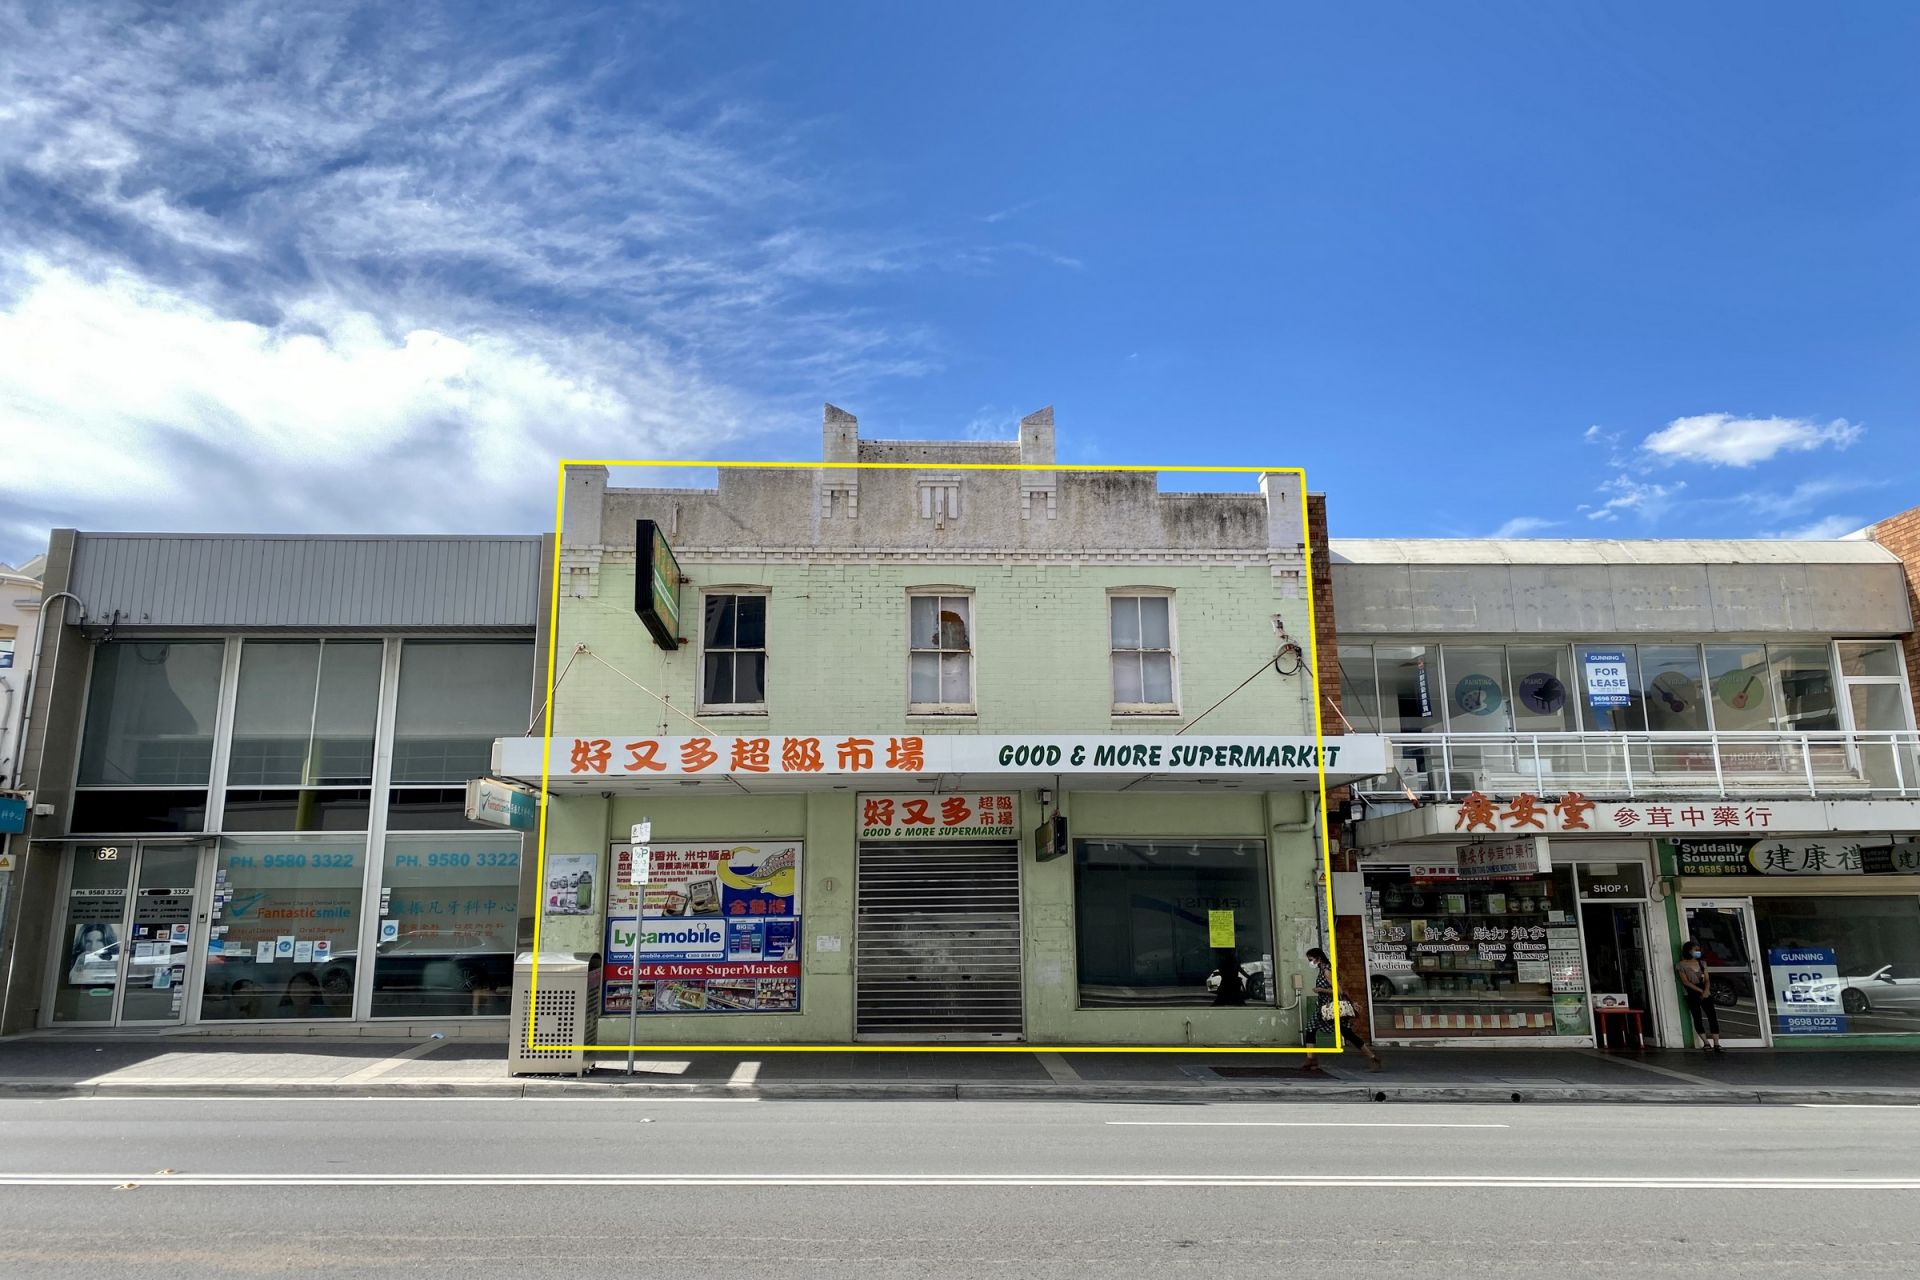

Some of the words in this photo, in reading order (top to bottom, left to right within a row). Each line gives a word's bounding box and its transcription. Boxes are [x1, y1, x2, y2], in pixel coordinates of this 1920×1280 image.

[1595, 668, 1618, 676] FOR
[1590, 679, 1626, 687] LEASE
[570, 737, 925, 773] 好又多超級市場
[998, 744, 1061, 766] GOOD
[1070, 745, 1086, 766] &
[1093, 744, 1162, 767] MORE
[1169, 744, 1341, 768] SUPERMARKET
[978, 796, 1013, 810] 超級
[863, 797, 972, 827] 好又多
[1455, 791, 1596, 832] 廣安堂
[1614, 806, 1773, 828] 參茸中藥行
[979, 812, 1013, 826] 市場
[863, 828, 892, 837] GOOD
[894, 828, 902, 836] &
[904, 827, 936, 836] MORE
[938, 826, 1015, 836] SUPERMARKET
[91, 848, 118, 860] 162
[1682, 843, 1744, 855] Syddaily
[230, 856, 256, 868] PH.
[264, 854, 306, 868] 9580
[312, 854, 354, 868] 3322
[395, 855, 422, 866] PH.
[428, 853, 470, 867] 9580
[476, 853, 519, 866] 3322
[1682, 854, 1746, 863] Souvenir
[1684, 866, 1697, 874] 02
[1724, 865, 1748, 873] 8613
[1593, 884, 1621, 893] SHOP
[256, 906, 352, 919] Fantasticsmile
[614, 927, 721, 946] Lycamobile
[1374, 943, 1408, 952] Chinese
[1416, 943, 1470, 954] Acupuncture
[1478, 943, 1506, 952] Sports
[1513, 942, 1547, 950] Chinese
[1480, 952, 1507, 962] Injury
[1513, 952, 1548, 961] Massage
[1781, 953, 1824, 961] GUNNING
[617, 966, 650, 976] Good
[654, 966, 666, 976] &
[670, 966, 703, 975] More
[706, 964, 788, 977] SuperMarket
[1374, 962, 1410, 970] Medicine
[1788, 1018, 1812, 1026] 9698
[1814, 1018, 1837, 1026] 0222
